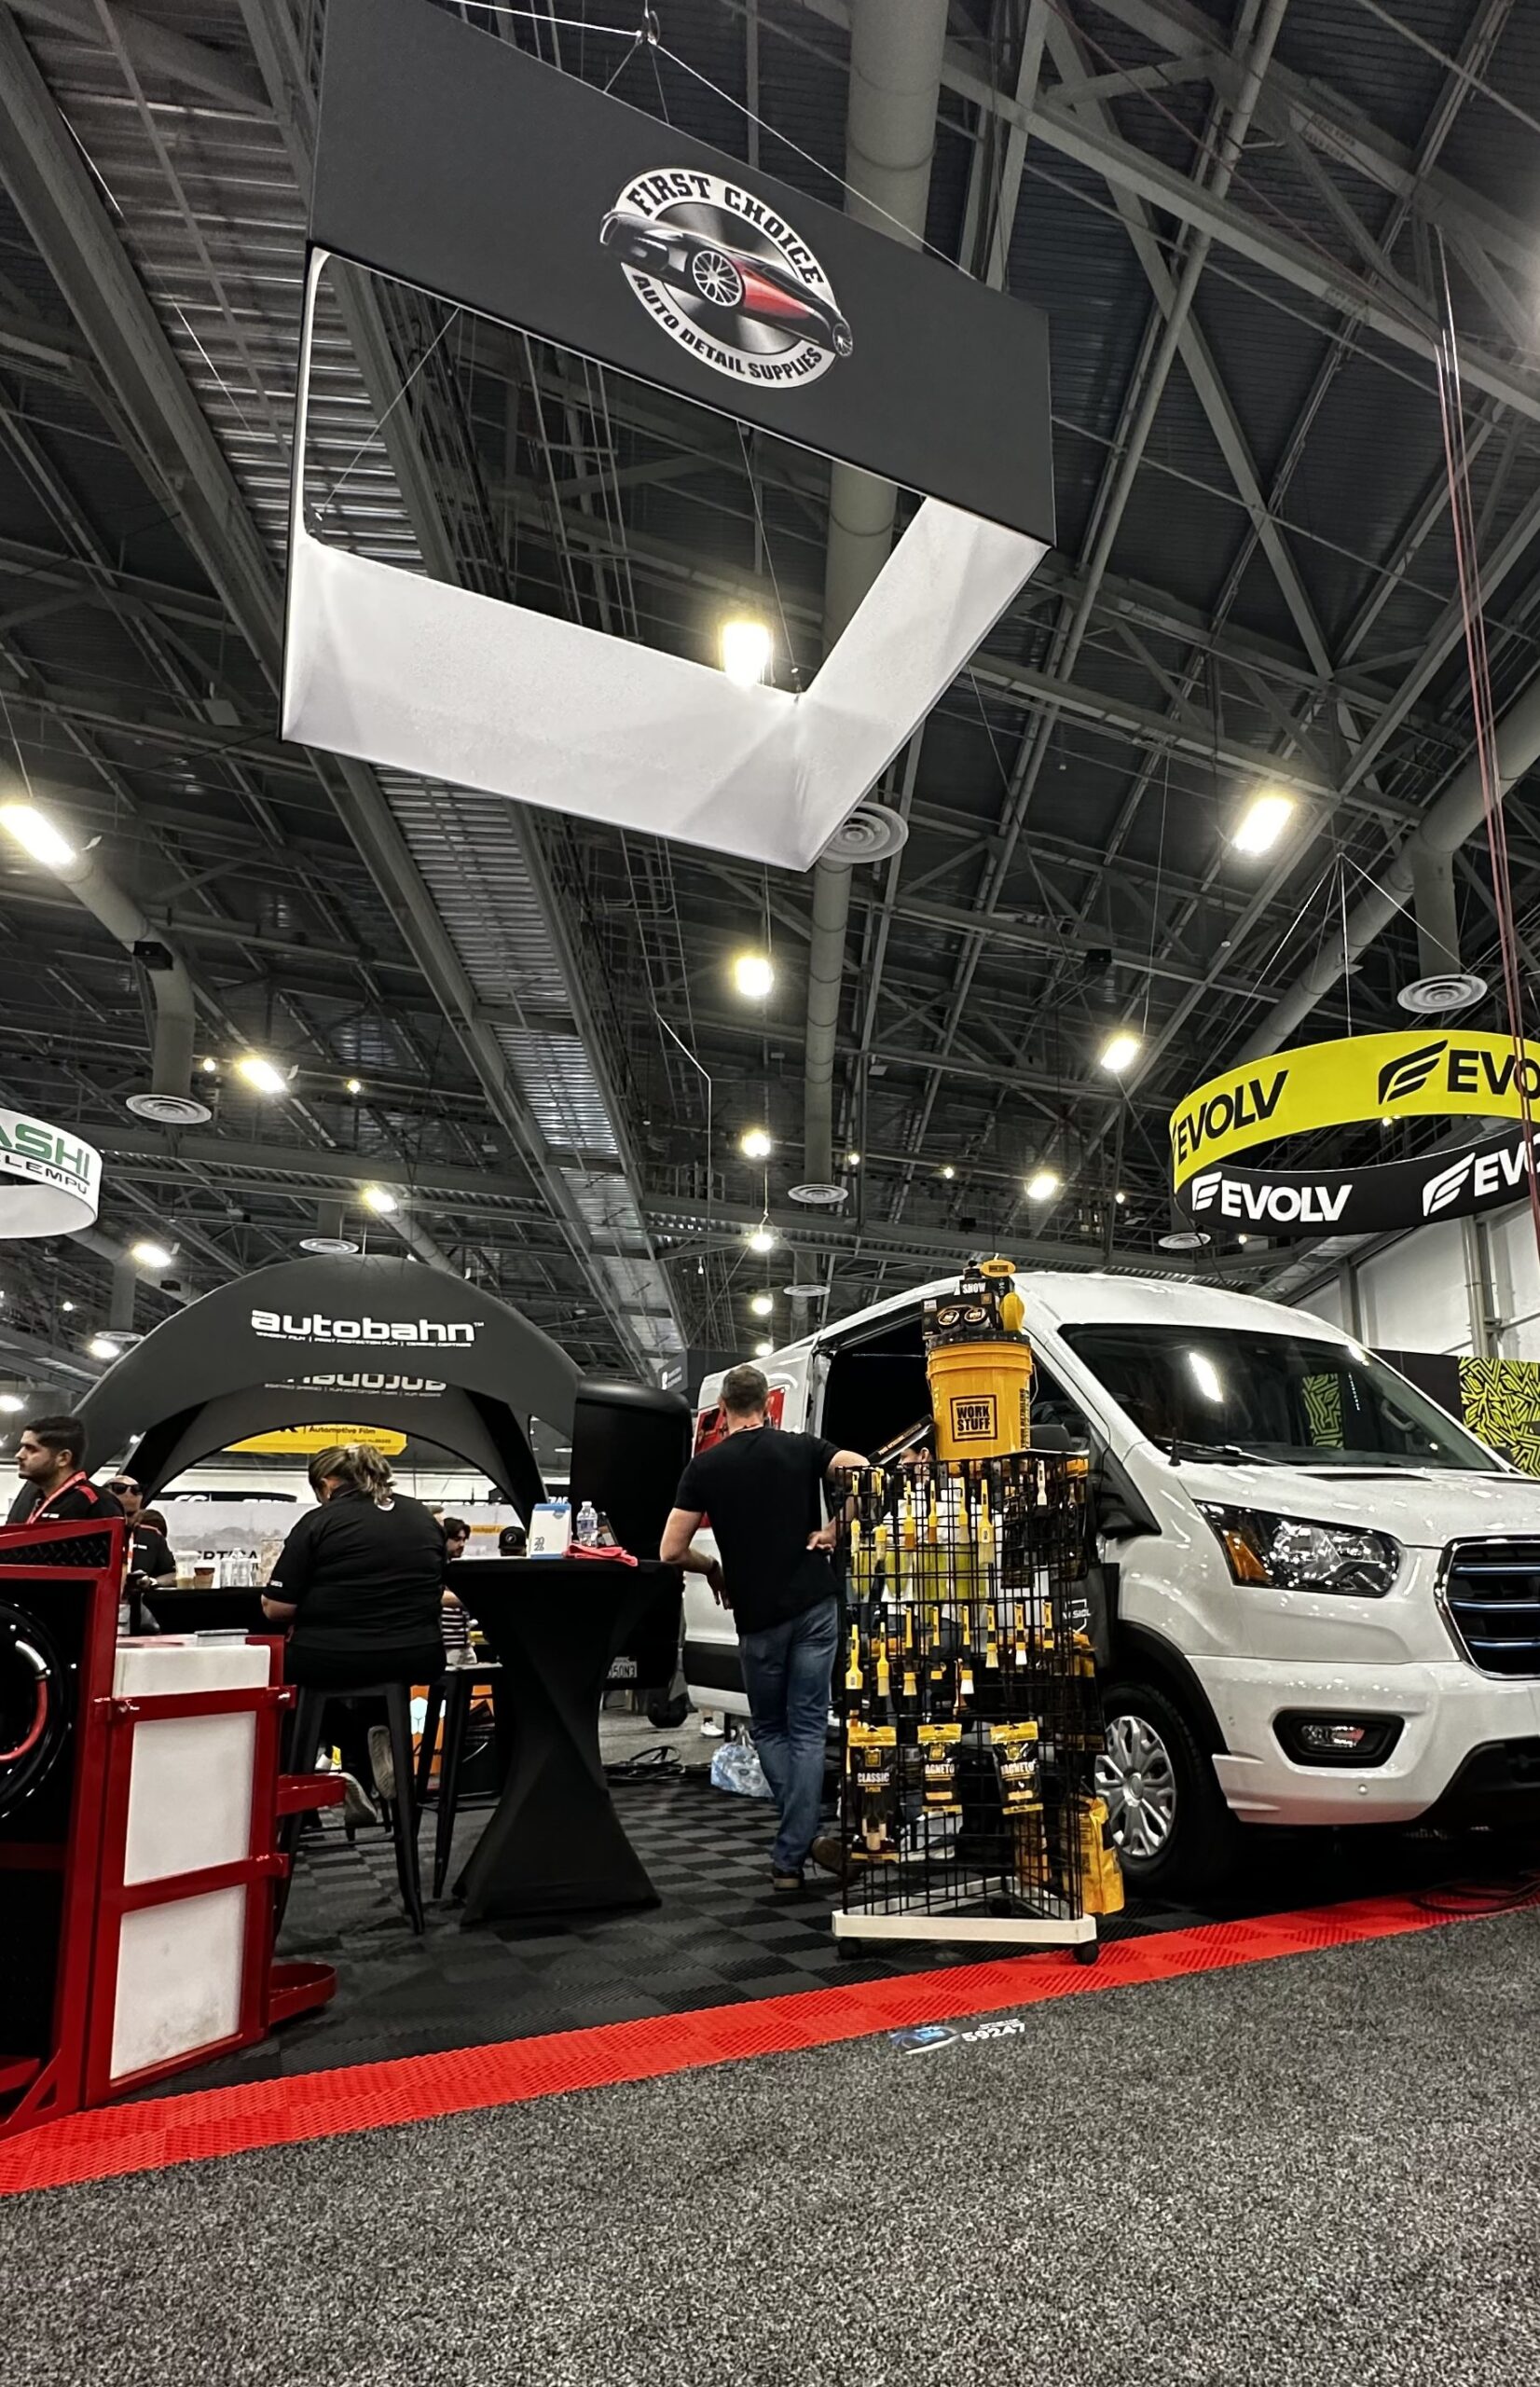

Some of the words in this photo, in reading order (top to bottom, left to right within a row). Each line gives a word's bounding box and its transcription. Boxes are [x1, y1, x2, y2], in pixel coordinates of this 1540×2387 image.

[626, 173, 711, 217] FIRST
[724, 186, 825, 285] CHOICE
[632, 274, 680, 330] AUTO
[679, 326, 747, 374] DETAIL
[749, 346, 823, 380] SUPPLIES
[1177, 1069, 1289, 1165] EVOLV
[0, 1154, 87, 1194] LEMPU
[1221, 1180, 1353, 1222] EVOLV
[251, 1309, 475, 1342] autobahn
[956, 1405, 990, 1419] WORK
[957, 1417, 990, 1431] STUFF
[858, 1773, 890, 1783] CLASSIC
[921, 1764, 955, 1774] AGNETO
